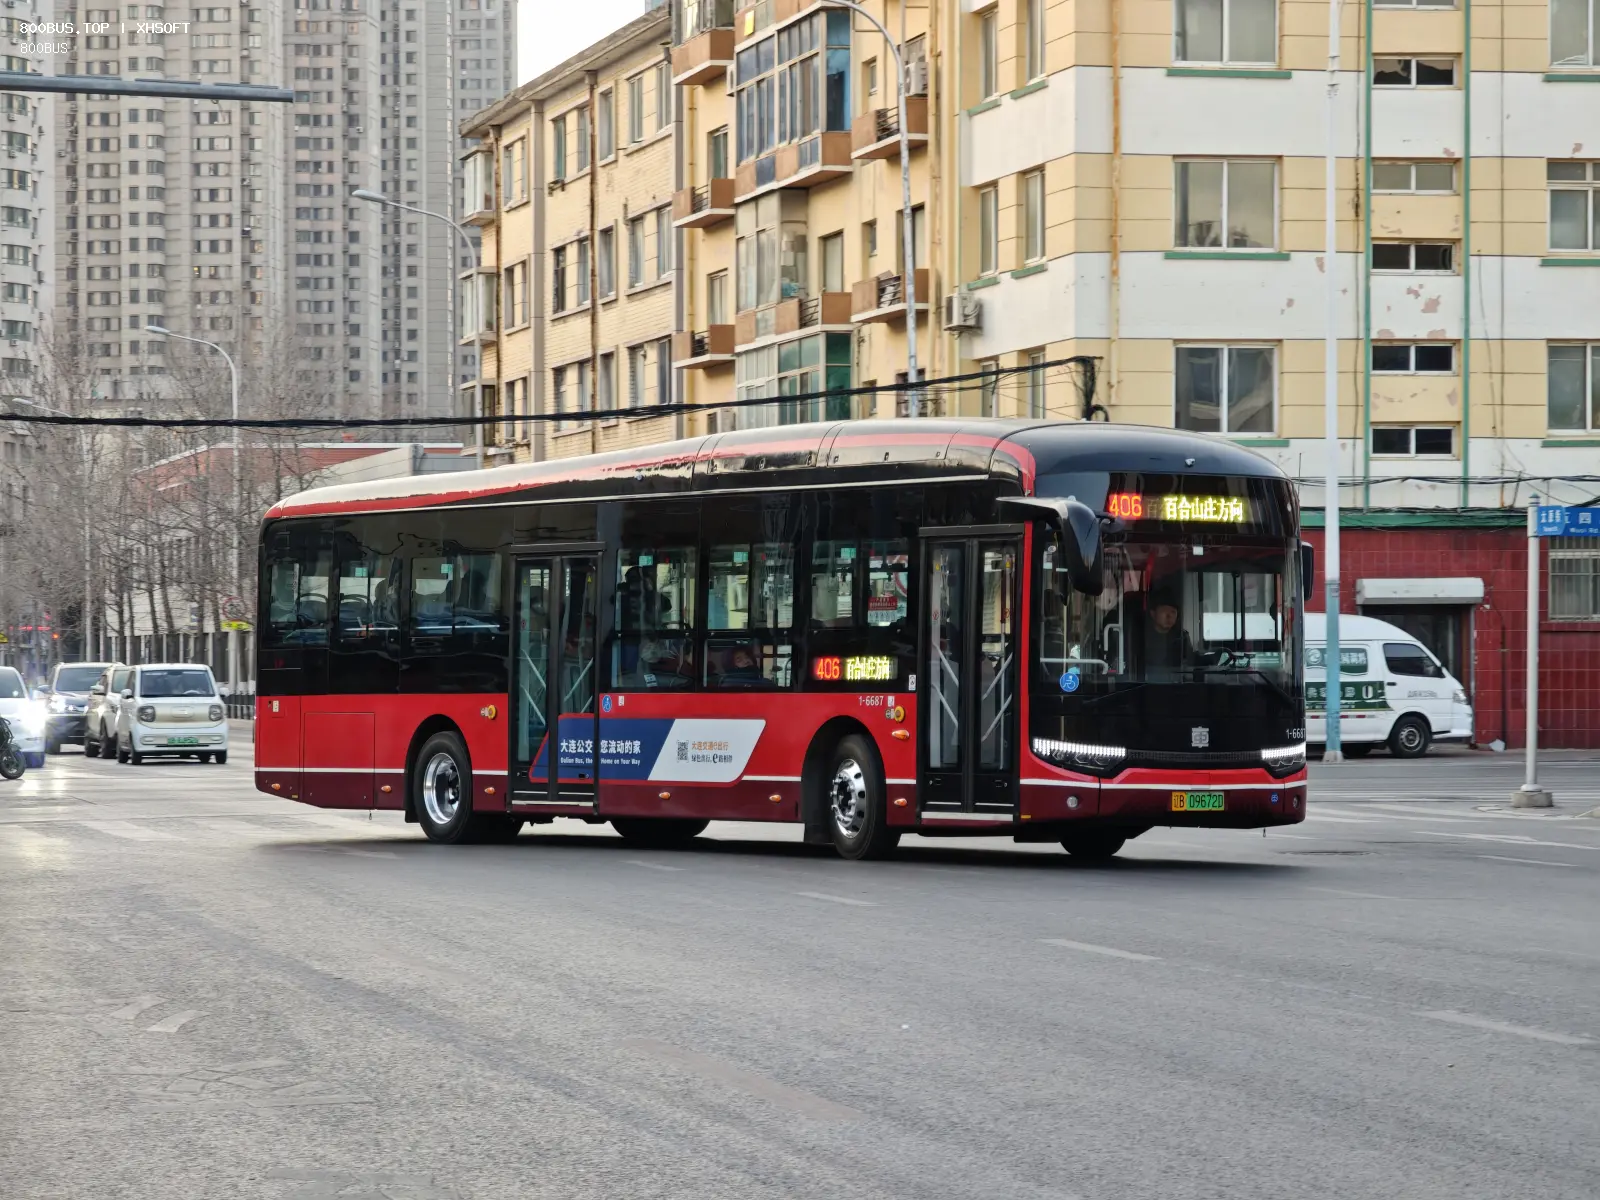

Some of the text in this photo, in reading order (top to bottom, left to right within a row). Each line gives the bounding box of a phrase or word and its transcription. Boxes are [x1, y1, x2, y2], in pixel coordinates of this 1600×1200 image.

[1109, 493, 1244, 522] 406 百合山庄方向
[816, 657, 841, 680] 406
[858, 695, 884, 706] 1-6687
[560, 739, 641, 755] 大连公交 您流动的家
